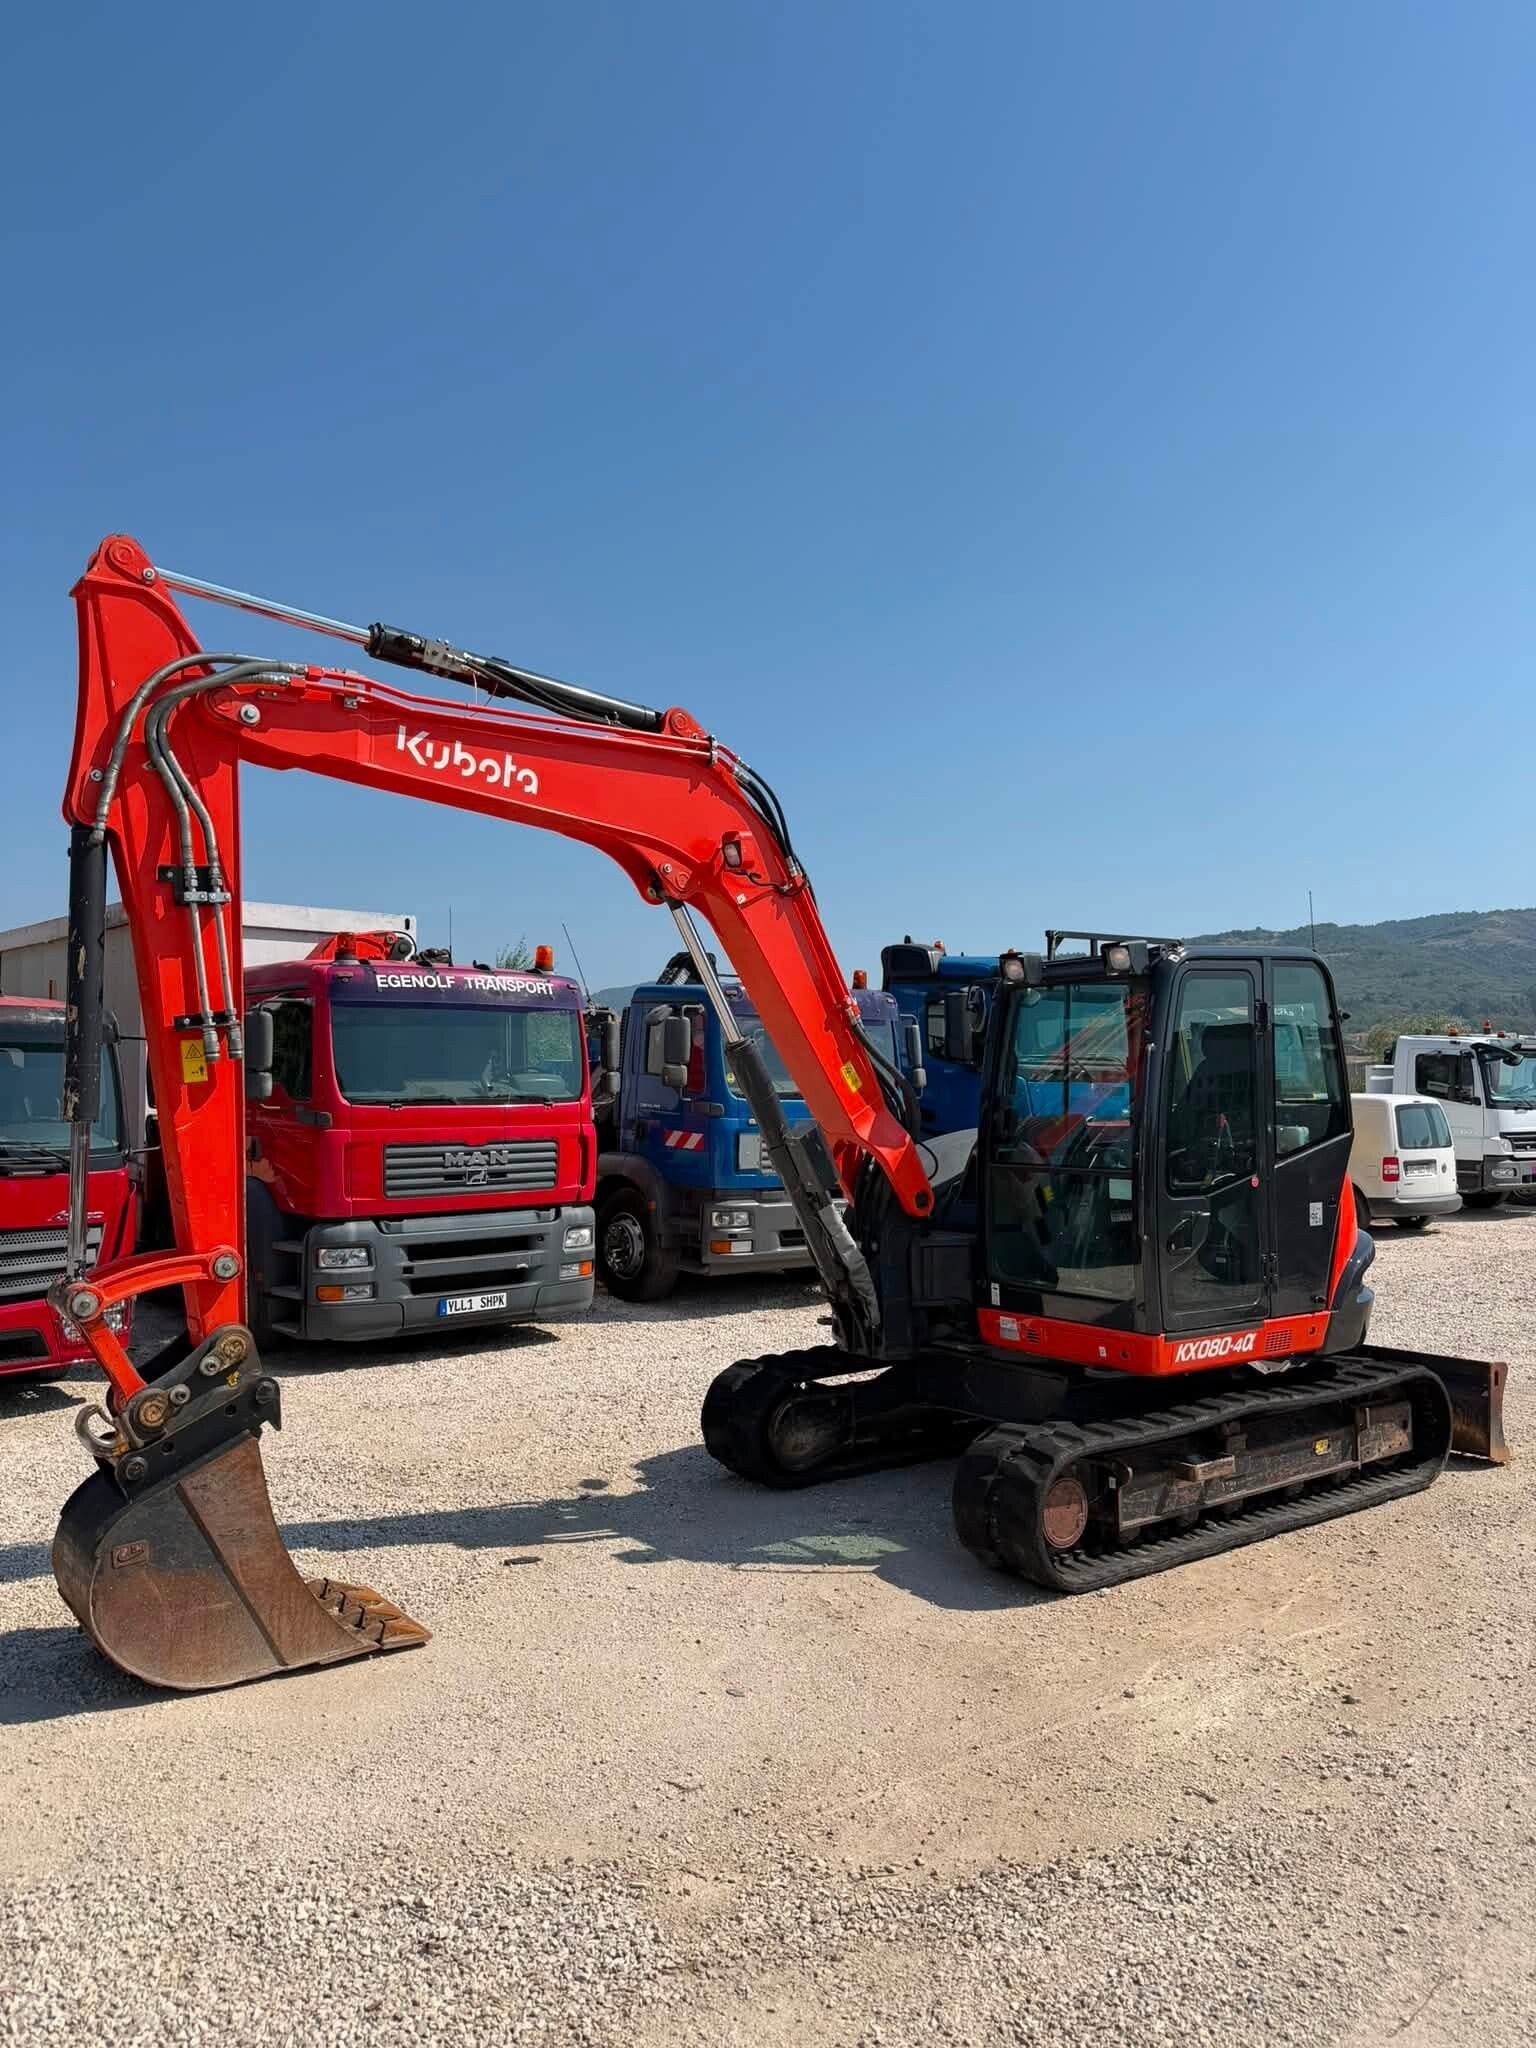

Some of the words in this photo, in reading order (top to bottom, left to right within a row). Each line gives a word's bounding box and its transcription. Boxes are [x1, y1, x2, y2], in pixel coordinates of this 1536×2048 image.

[396, 725, 538, 795] Kubota
[375, 974, 456, 989] EGENOLF
[464, 976, 555, 995] TRANSPORT
[444, 1150, 510, 1168] MAN
[480, 1294, 505, 1309] SHPK
